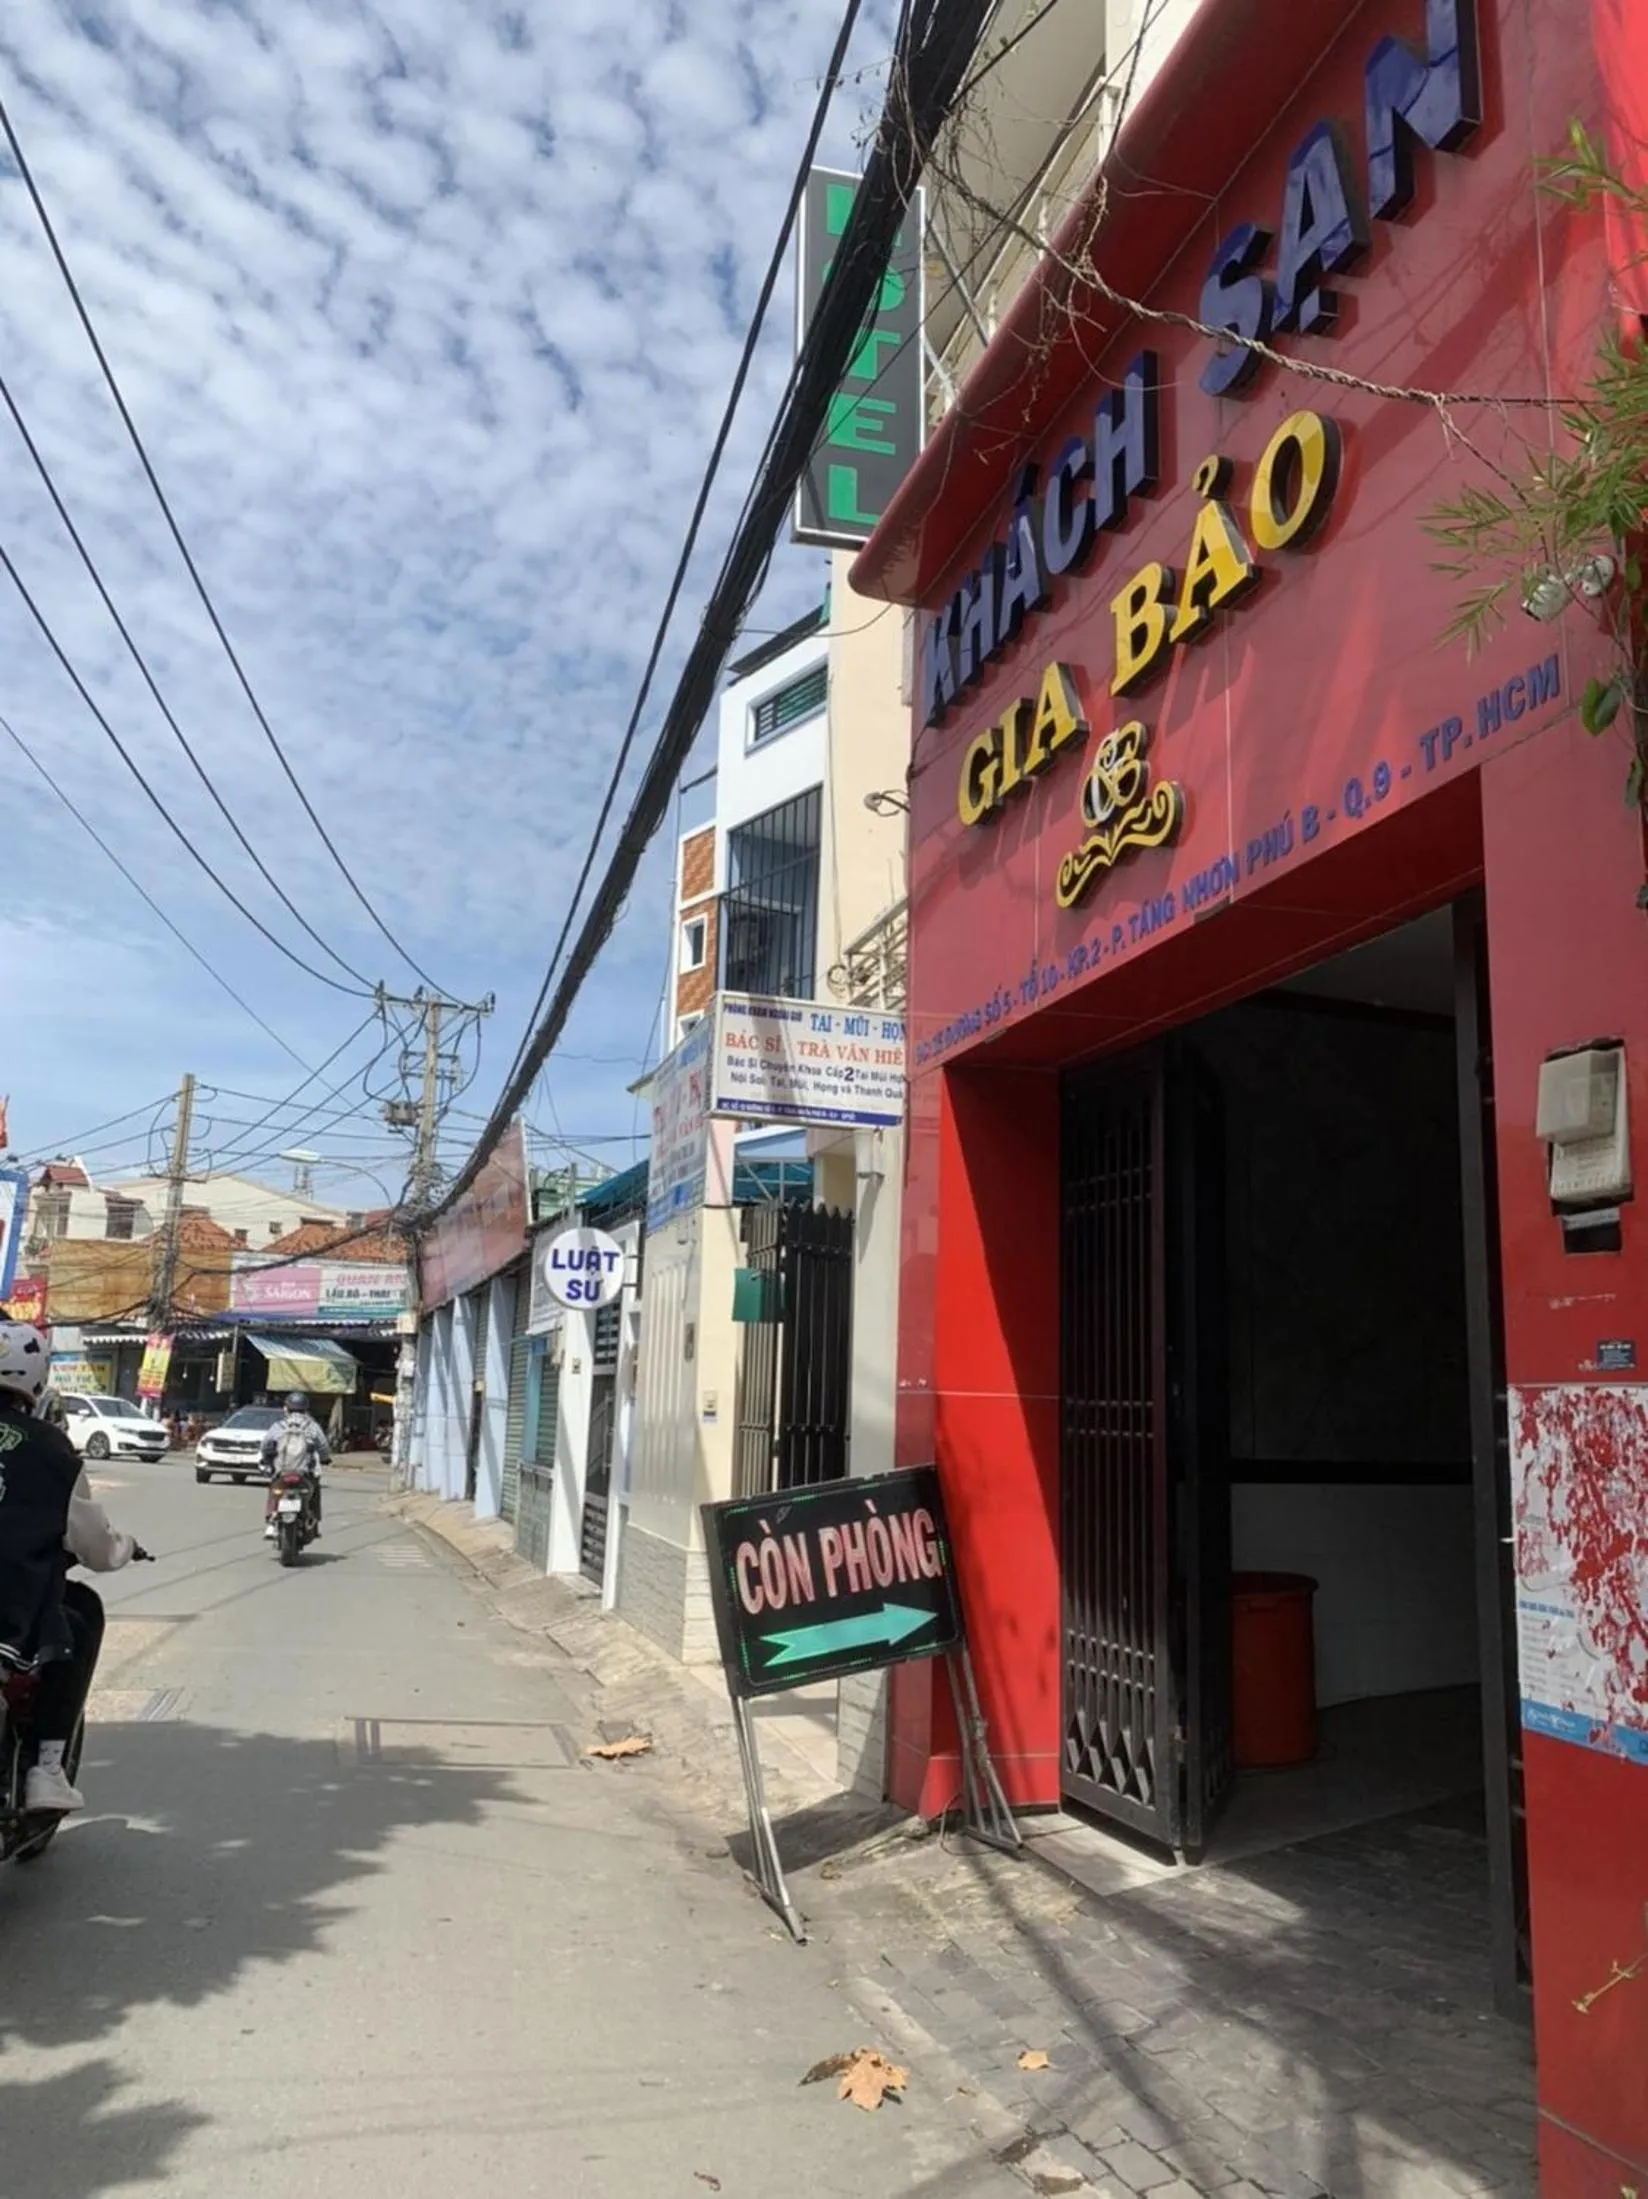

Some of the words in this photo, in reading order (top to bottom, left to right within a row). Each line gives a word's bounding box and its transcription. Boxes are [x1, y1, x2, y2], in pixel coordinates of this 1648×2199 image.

[921, 350, 1160, 730] KHÁCH
[1198, 0, 1482, 397] SẠN
[959, 661, 1089, 826] GIA
[1109, 409, 1341, 697] BẢO
[1181, 848, 1241, 914] NHƠN
[1245, 809, 1296, 877] PHÚ
[1299, 805, 1322, 844] B
[1342, 760, 1392, 819] Q.9
[811, 1013, 832, 1033] TAI
[844, 1014, 869, 1037] MŨI
[725, 1029, 761, 1050] BÁC
[798, 1037, 831, 1059] TRÀ
[844, 1066, 855, 1083] 2
[854, 1084, 883, 1098] Thanh
[551, 1246, 620, 1276] LUẬT
[566, 1278, 604, 1302] SƯ
[735, 1519, 816, 1616] CÒN
[818, 1499, 942, 1598] PHÒNG
